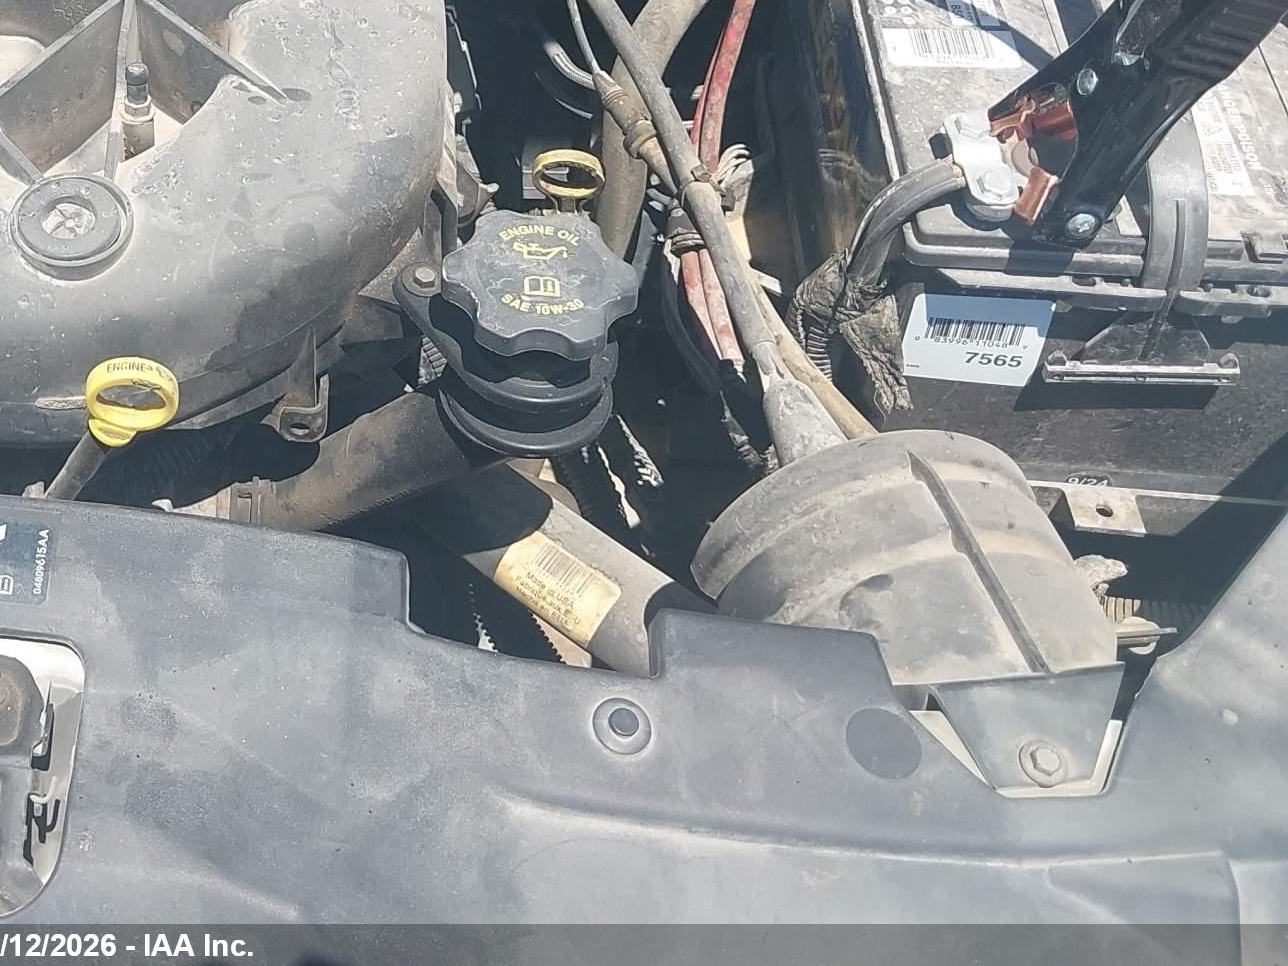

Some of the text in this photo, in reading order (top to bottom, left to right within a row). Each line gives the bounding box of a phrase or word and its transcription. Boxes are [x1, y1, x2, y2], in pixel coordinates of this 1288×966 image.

[498, 224, 581, 246] ENGINE OIL
[501, 294, 584, 315] SAE 10W-30
[933, 336, 968, 346] 83996
[106, 361, 146, 374] ENGINE
[964, 351, 1023, 368] 7565
[32, 529, 50, 595] 04809615AA
[525, 571, 547, 590] Made
